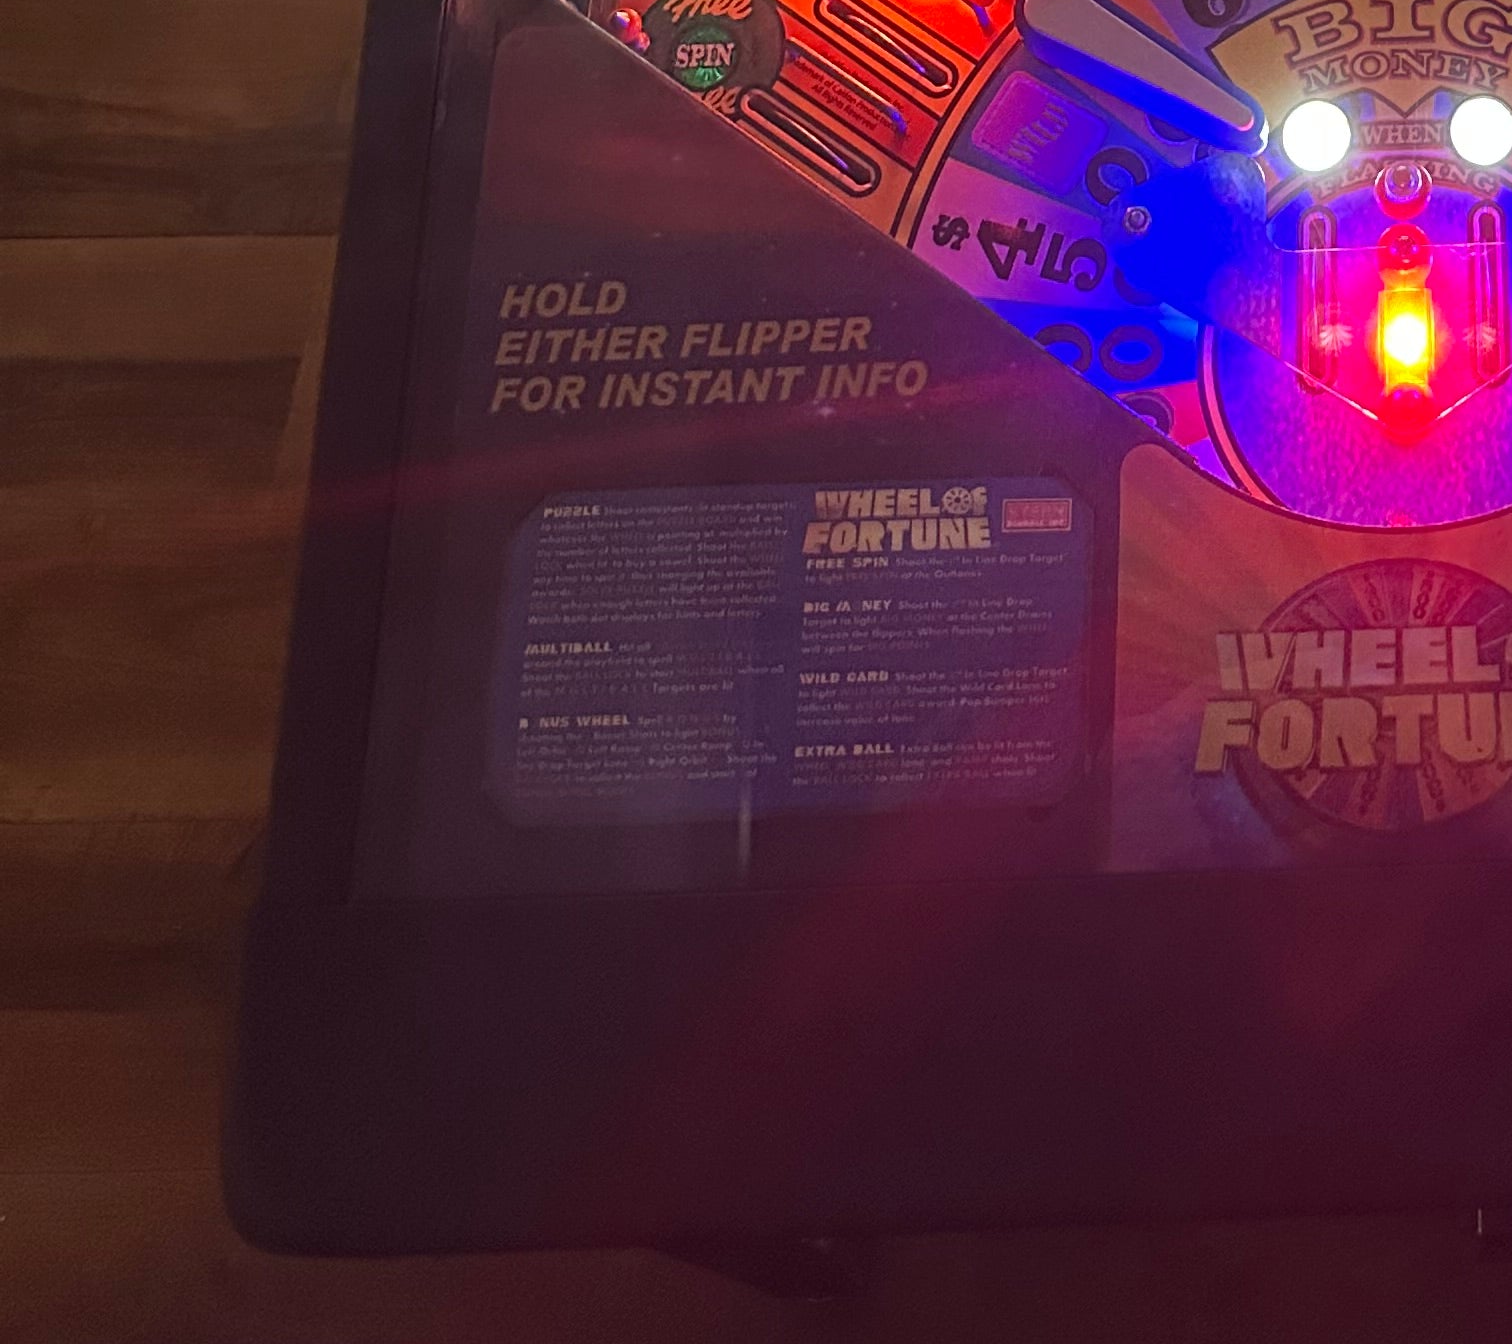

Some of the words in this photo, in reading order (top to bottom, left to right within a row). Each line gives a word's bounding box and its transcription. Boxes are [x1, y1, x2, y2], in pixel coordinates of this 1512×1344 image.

[675, 43, 735, 67] SPIN
[1303, 48, 1509, 94] MONEY
[1361, 125, 1443, 145] WHEN
[1317, 160, 1498, 198] FLAING
[499, 280, 628, 319] HOLD
[495, 325, 668, 366] EITHER
[679, 315, 872, 359] FLIPPER
[490, 375, 587, 413] FOR
[599, 366, 806, 409] INSTANT
[816, 359, 929, 400] INFO
[543, 503, 602, 520] PUZZLE
[815, 487, 941, 519] WHEEL
[802, 519, 992, 555] FORTUNE
[806, 558, 846, 570] FREE
[852, 556, 889, 569] SPIN
[803, 600, 830, 613] BIG
[524, 640, 613, 657] MULTIBALL
[1215, 624, 1502, 693] WHEEL
[800, 671, 841, 685] WILD
[846, 670, 890, 684] CARD
[576, 714, 631, 728] WHEEL
[794, 744, 848, 759] EXTRA
[853, 742, 896, 757] BALL
